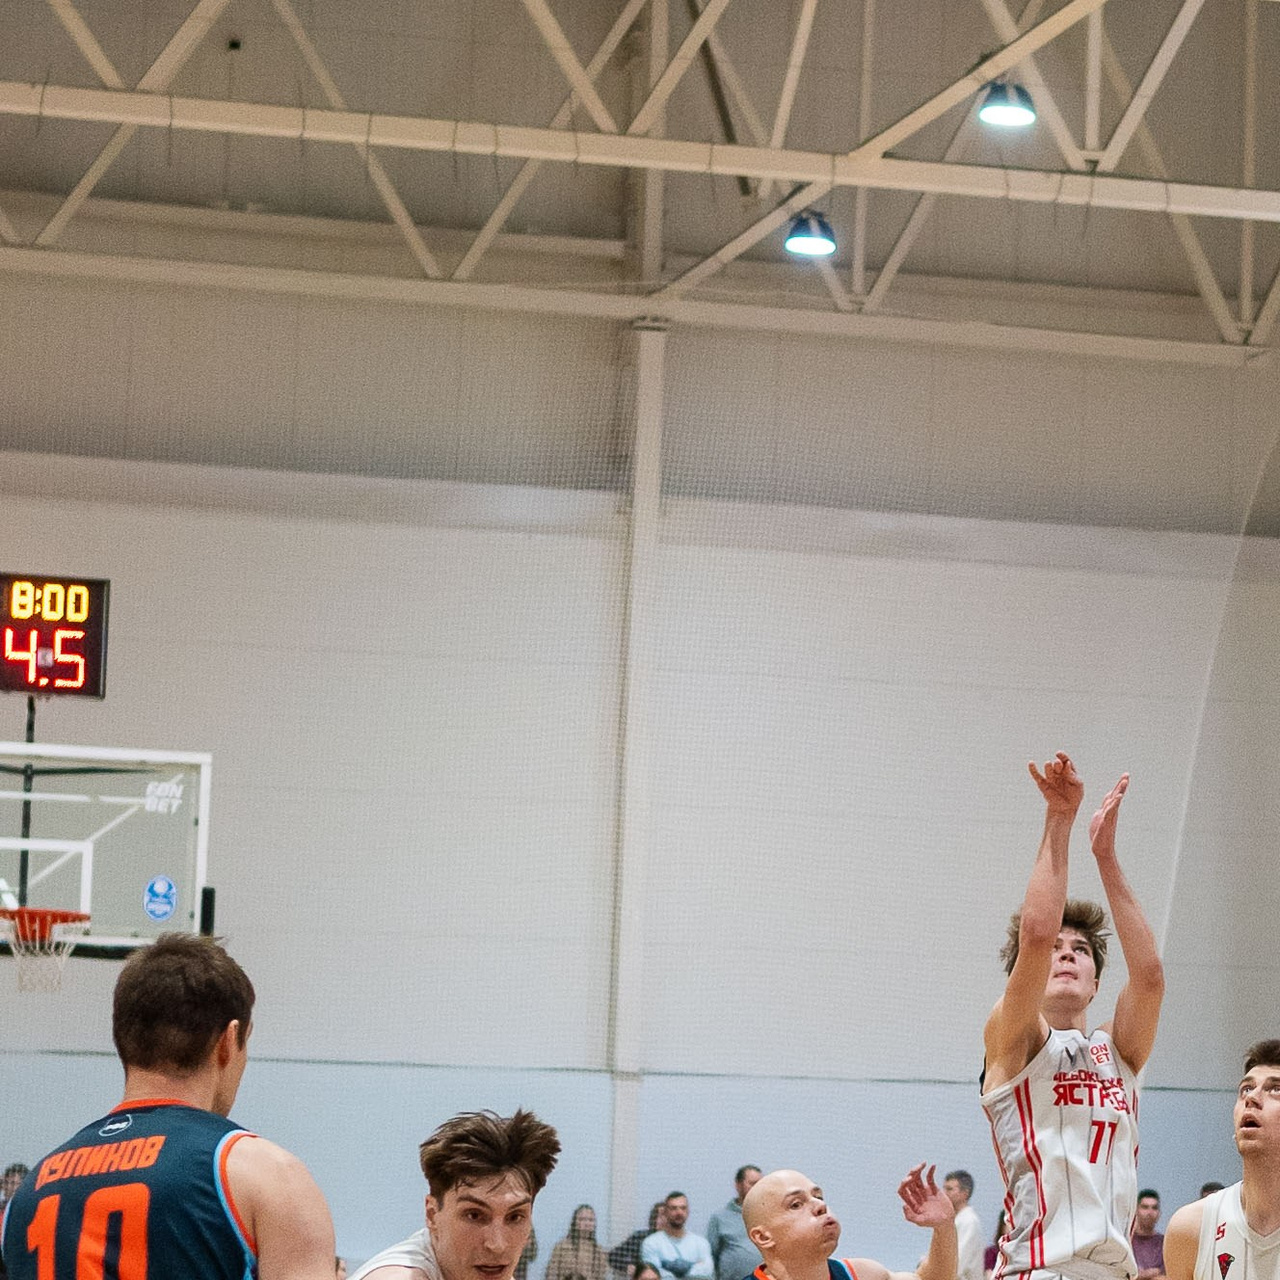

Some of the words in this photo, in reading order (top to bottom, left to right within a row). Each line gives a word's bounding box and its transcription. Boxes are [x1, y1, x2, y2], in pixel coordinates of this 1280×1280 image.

[10, 580, 90, 623] 8:00
[4, 627, 86, 688] 4.5
[1094, 1054, 1110, 1066] ET
